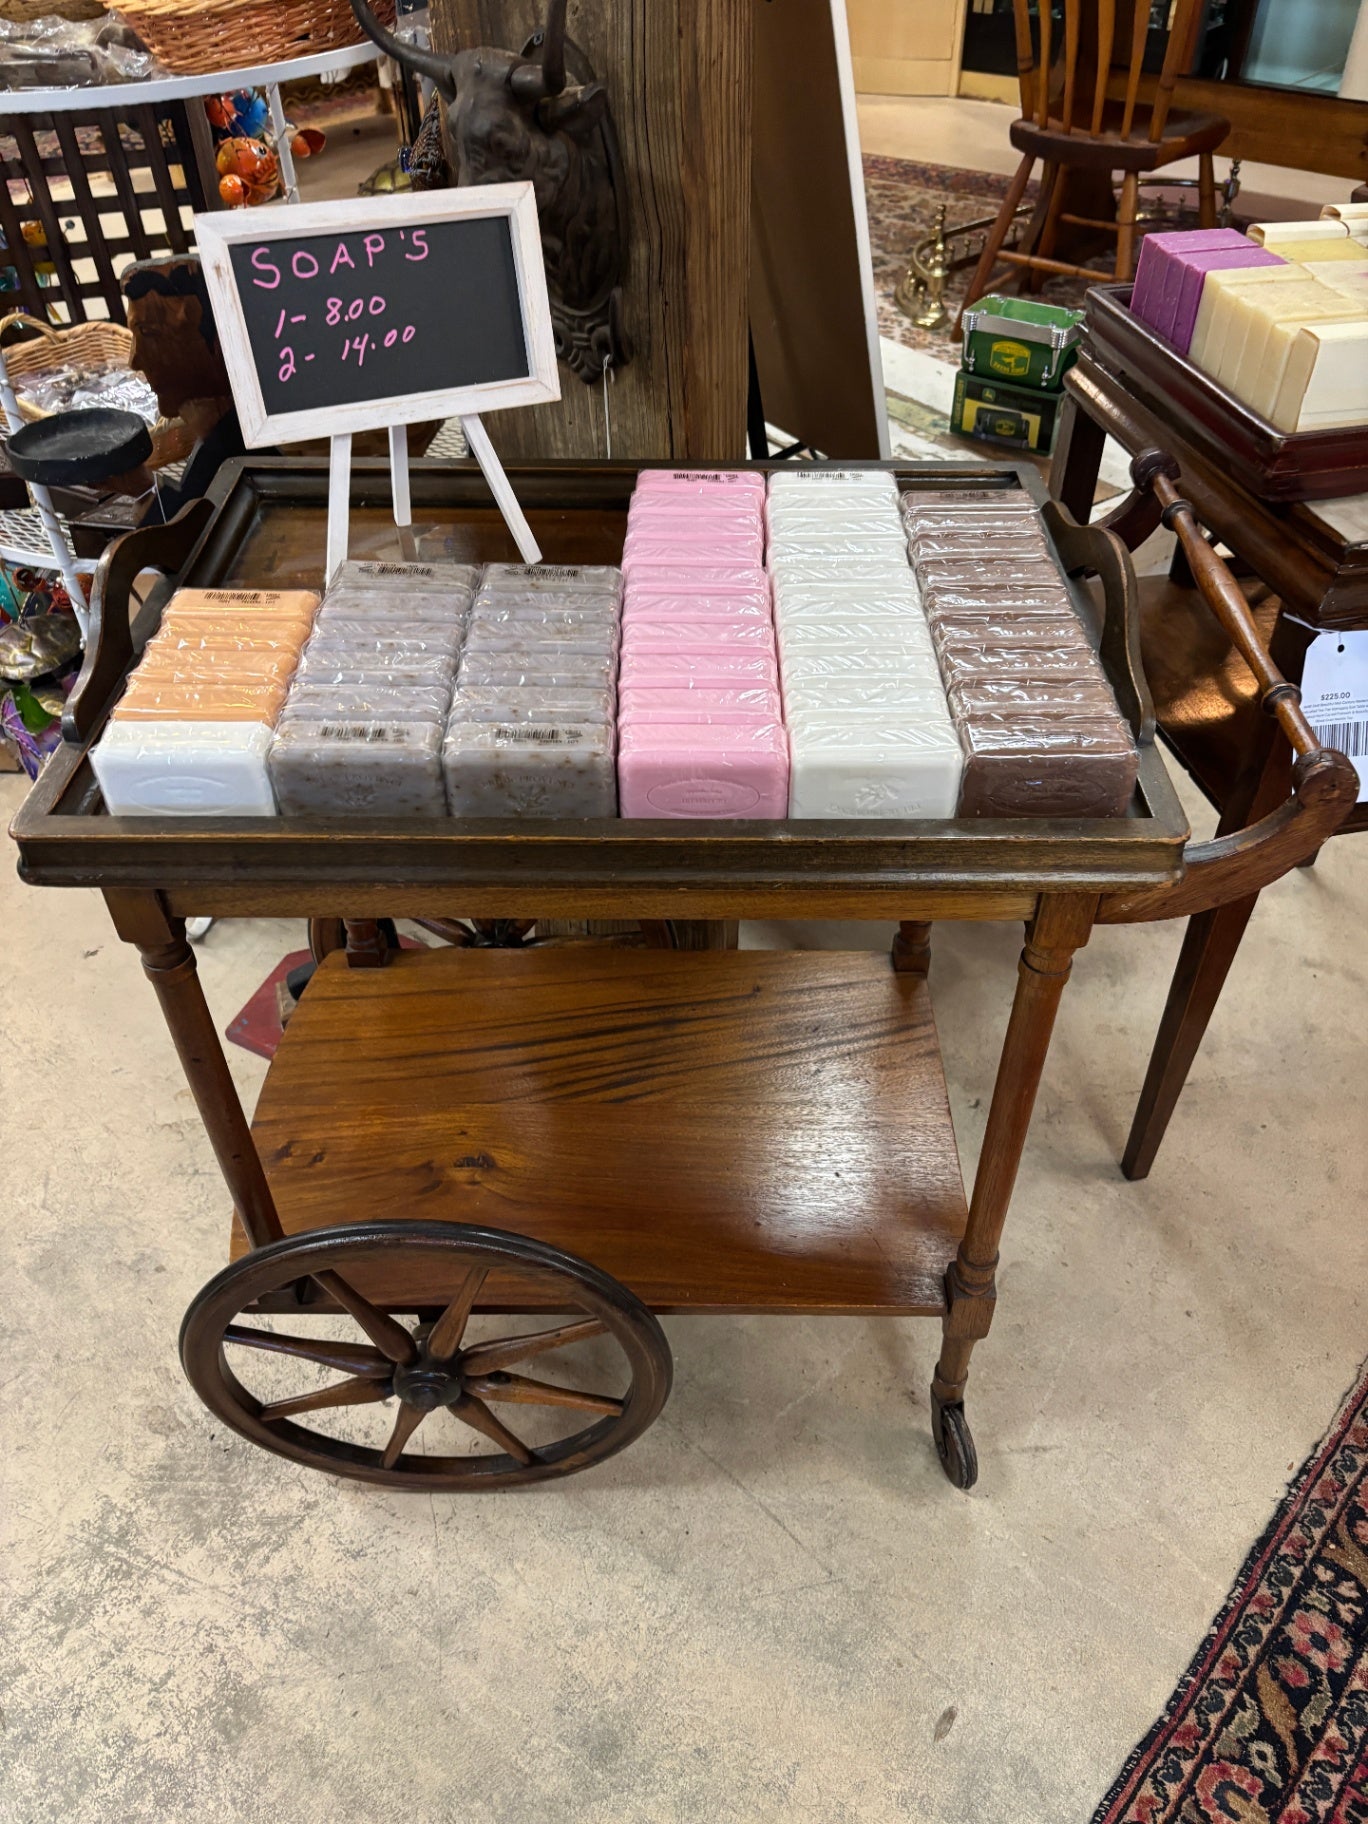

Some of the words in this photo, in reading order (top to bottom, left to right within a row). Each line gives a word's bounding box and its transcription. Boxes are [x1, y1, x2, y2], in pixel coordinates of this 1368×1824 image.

[251, 230, 430, 289] SOAP'S
[325, 296, 387, 326] 8.00
[341, 325, 416, 367] 14.00
[1320, 692, 1351, 700] $225.00
